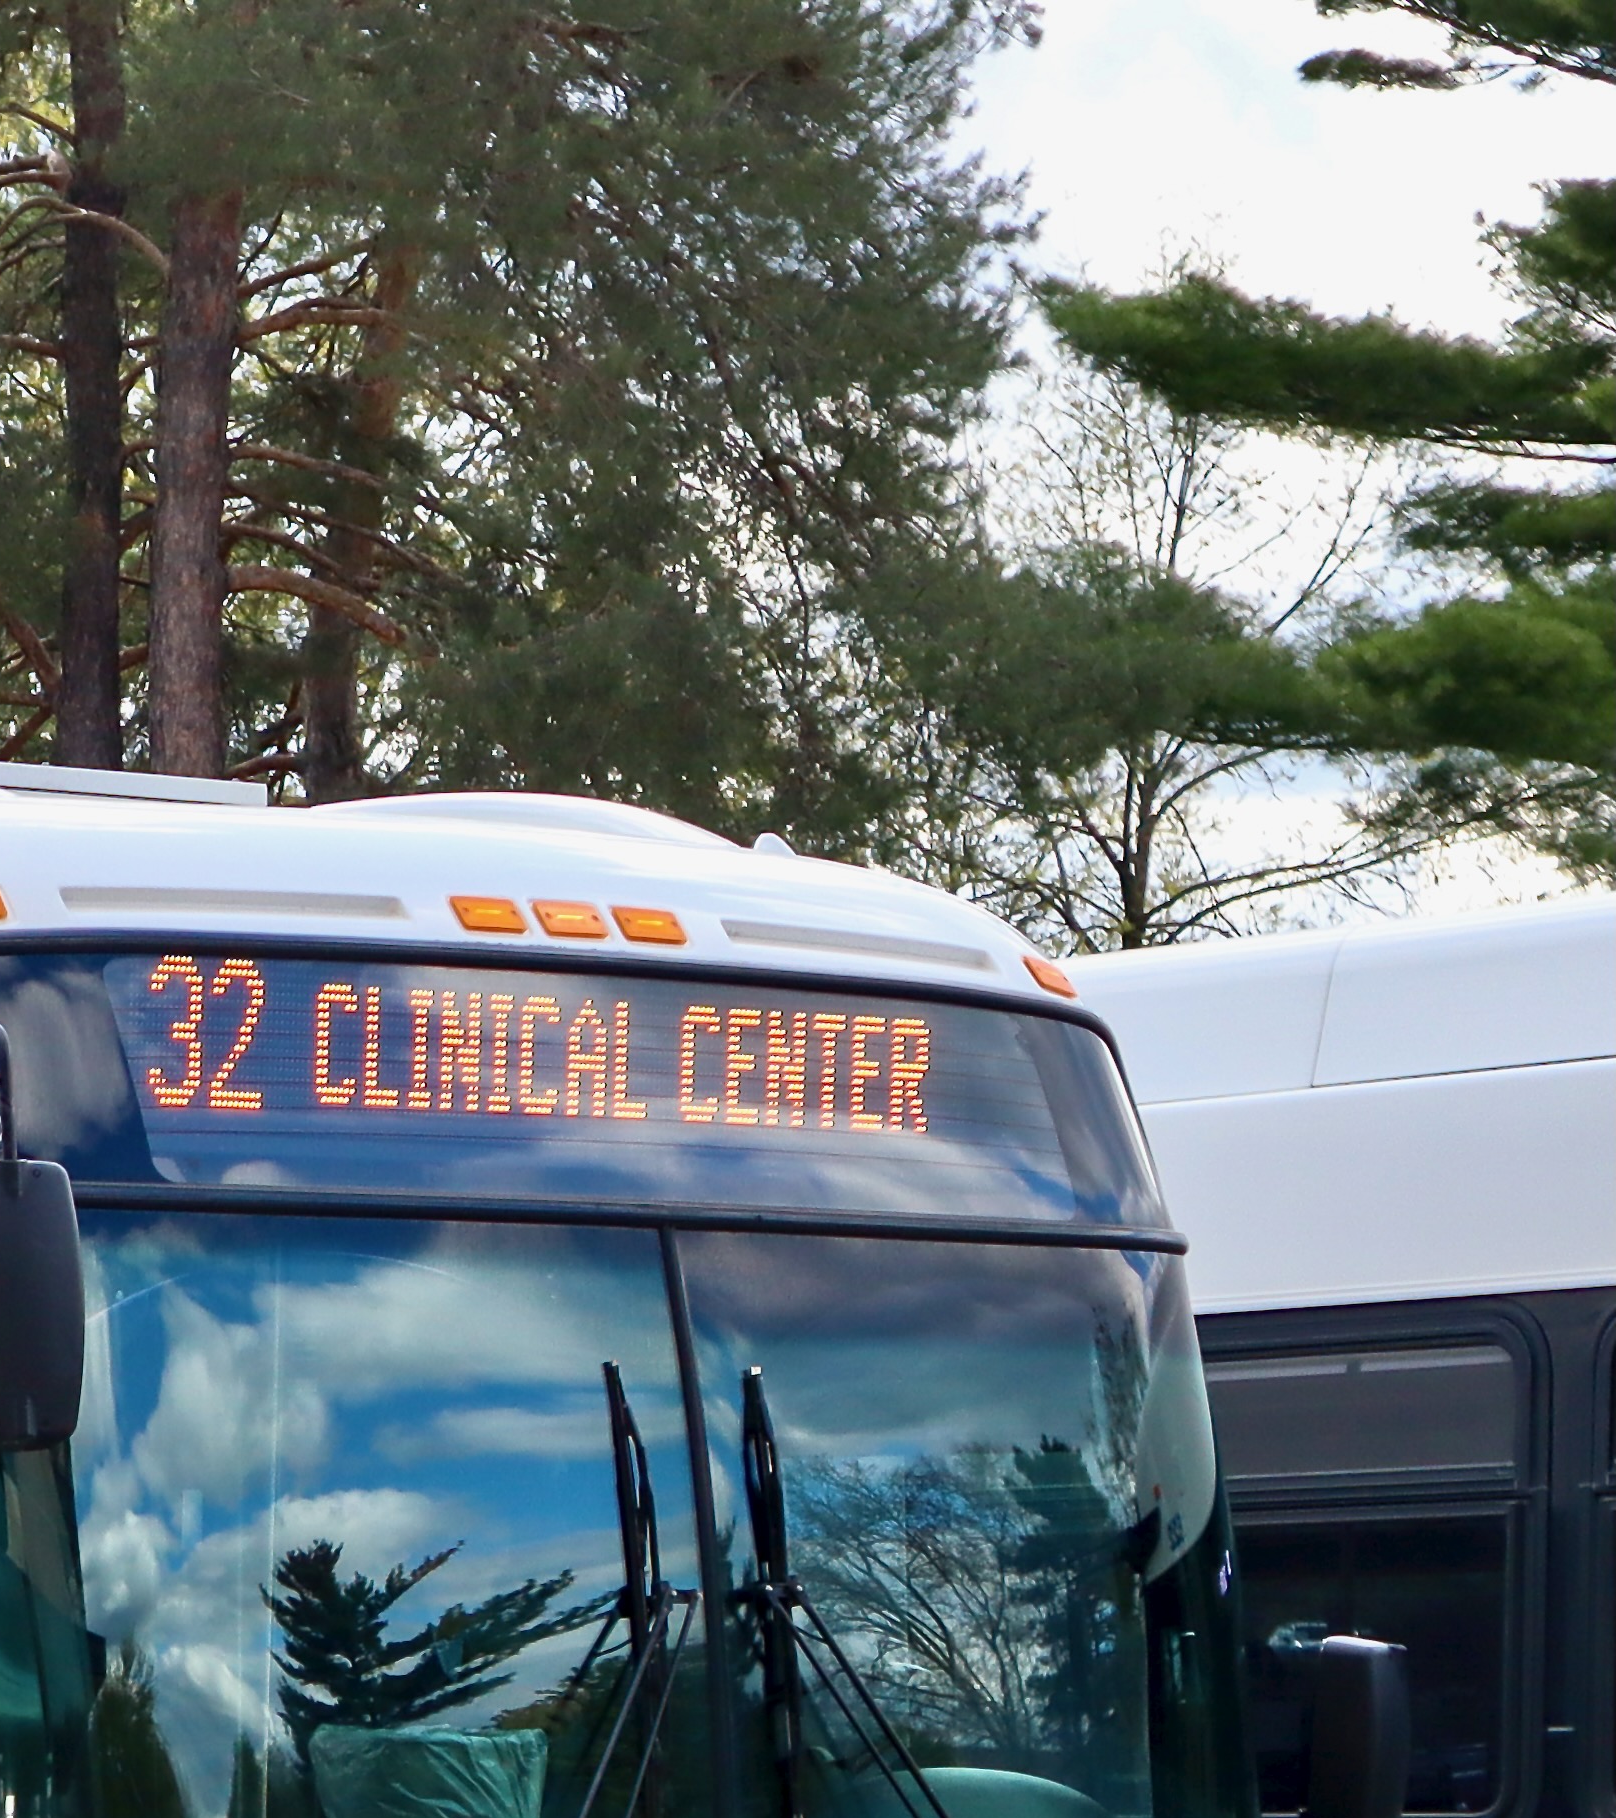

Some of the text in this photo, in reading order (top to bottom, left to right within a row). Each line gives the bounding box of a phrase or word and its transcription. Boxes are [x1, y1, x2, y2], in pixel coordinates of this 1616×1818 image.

[147, 954, 931, 1133] 32 CLINICAL CENTER
